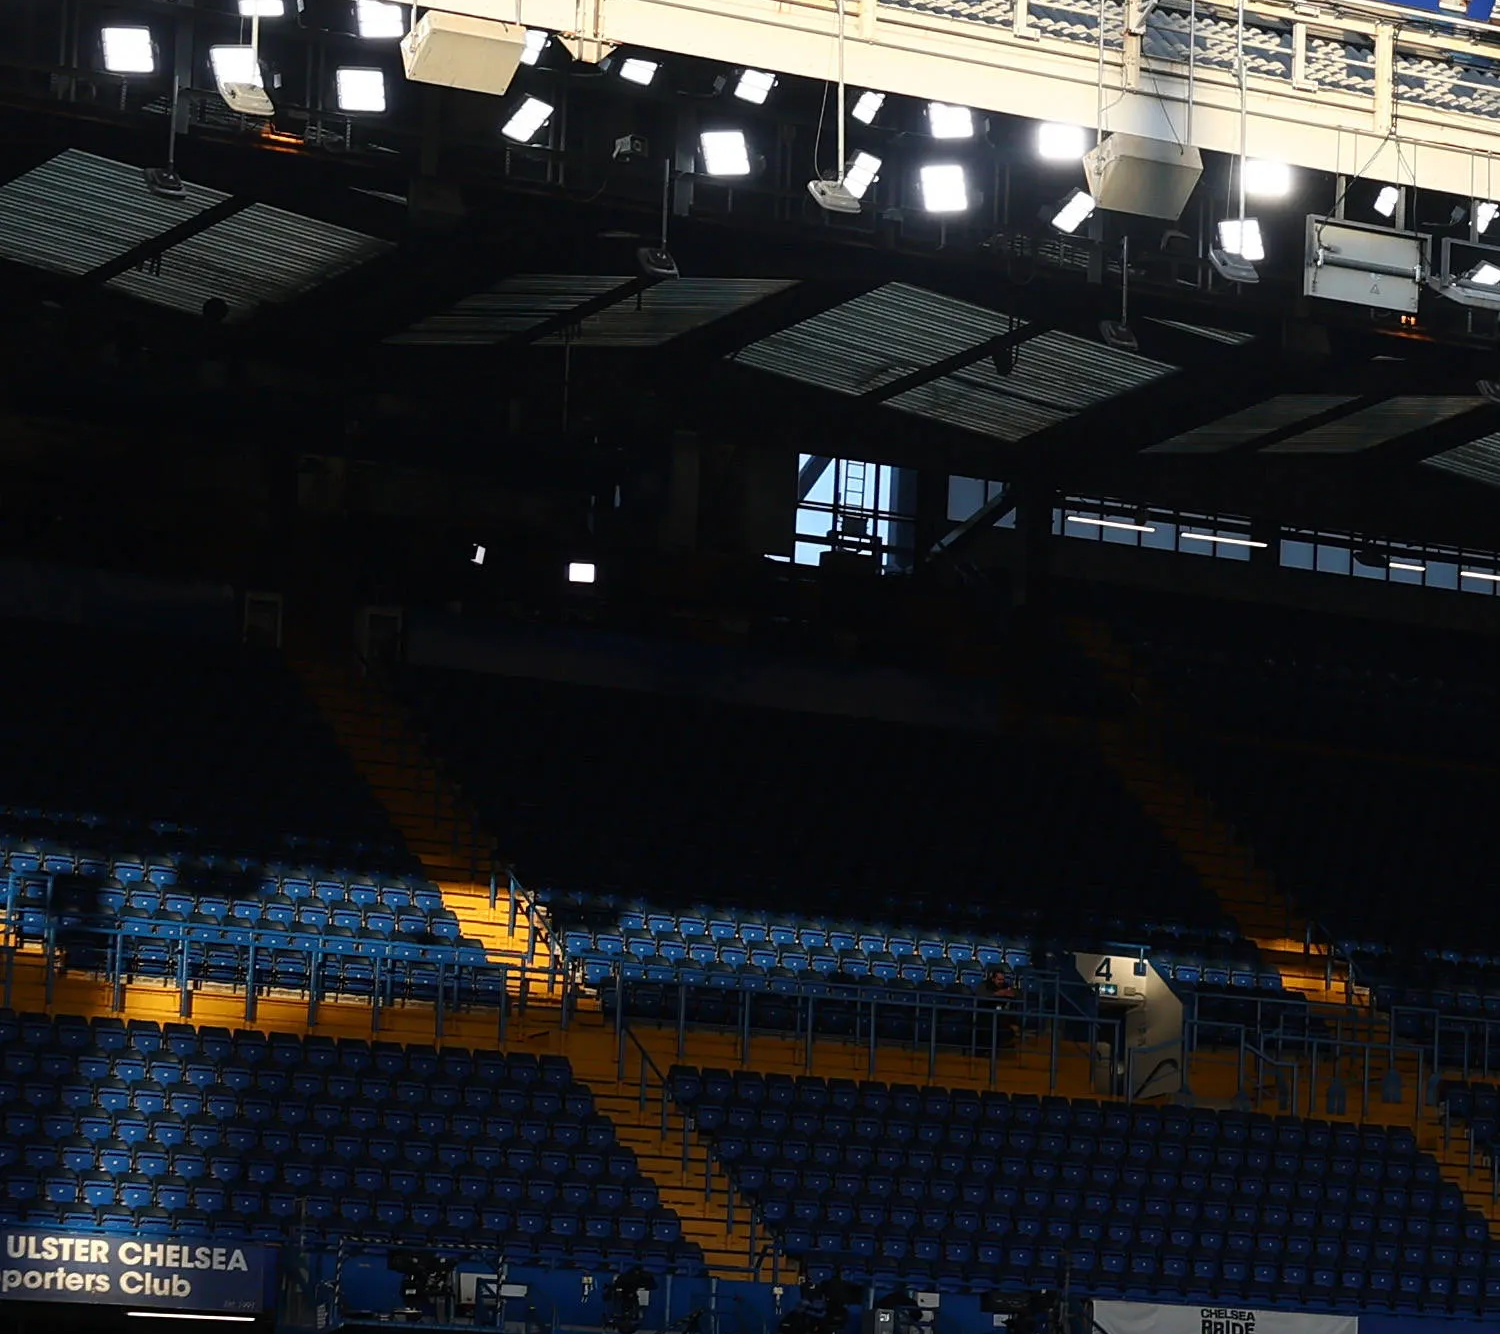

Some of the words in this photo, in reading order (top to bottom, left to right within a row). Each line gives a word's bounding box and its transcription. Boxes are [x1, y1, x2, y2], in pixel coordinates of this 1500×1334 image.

[1095, 957, 1112, 981] 4
[7, 1235, 109, 1264] ULSTER
[118, 1242, 249, 1272] CHELSEA
[0, 1267, 111, 1293] porters
[119, 1271, 192, 1298] Club
[1201, 1308, 1255, 1322] CHELSEA
